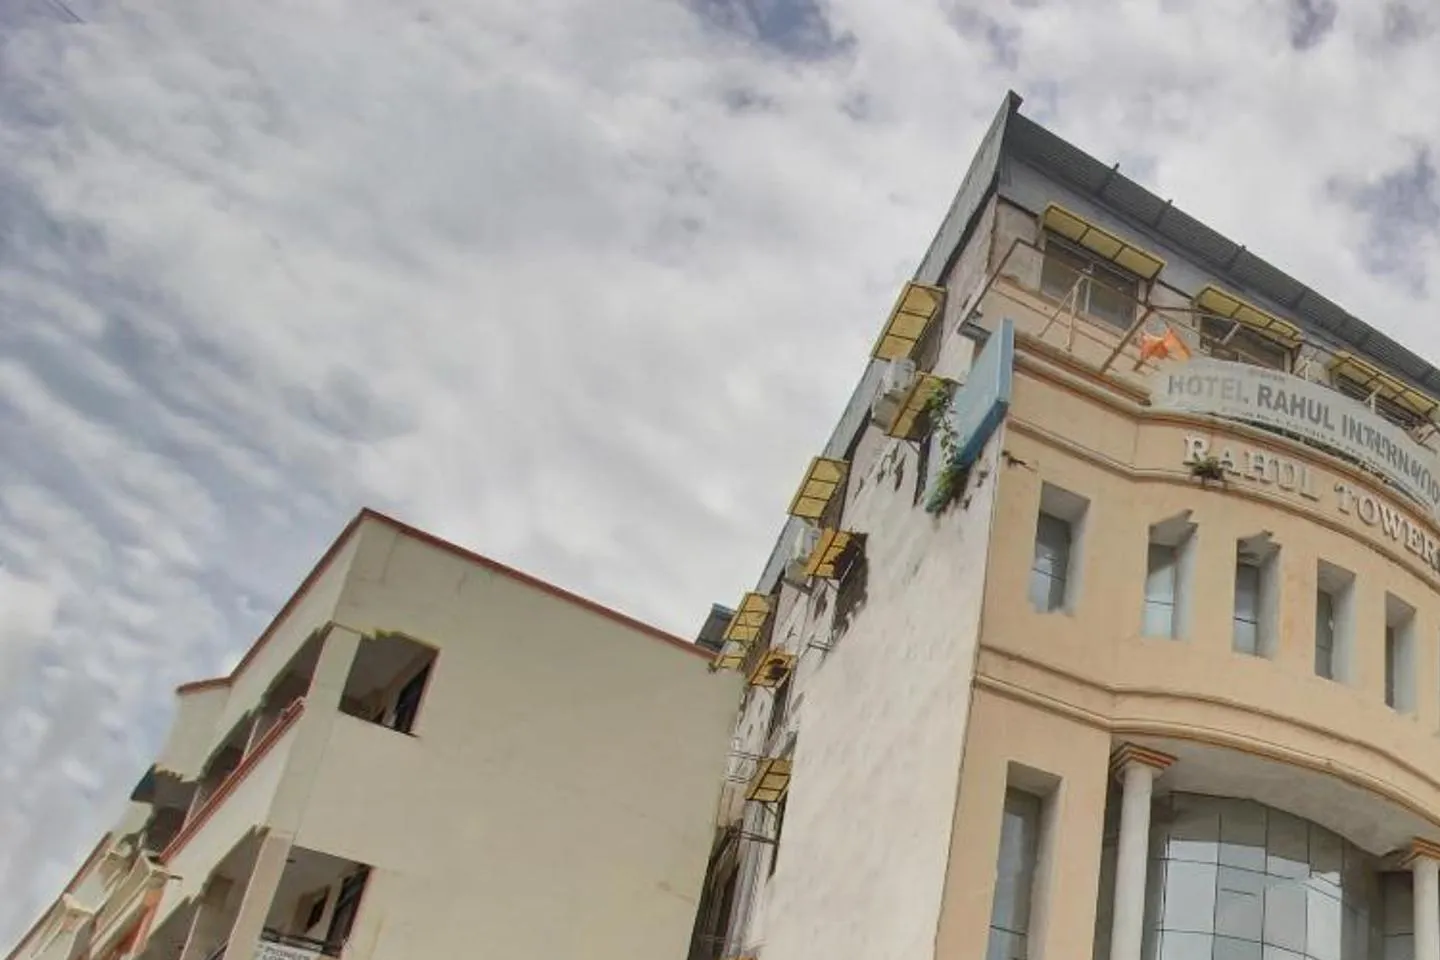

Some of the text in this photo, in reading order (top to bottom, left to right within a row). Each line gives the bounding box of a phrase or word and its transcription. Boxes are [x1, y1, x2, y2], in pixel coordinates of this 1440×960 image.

[1168, 374, 1248, 404] HOTEL
[1256, 383, 1336, 432] RAHUL
[1184, 432, 1320, 501] RAHUL
